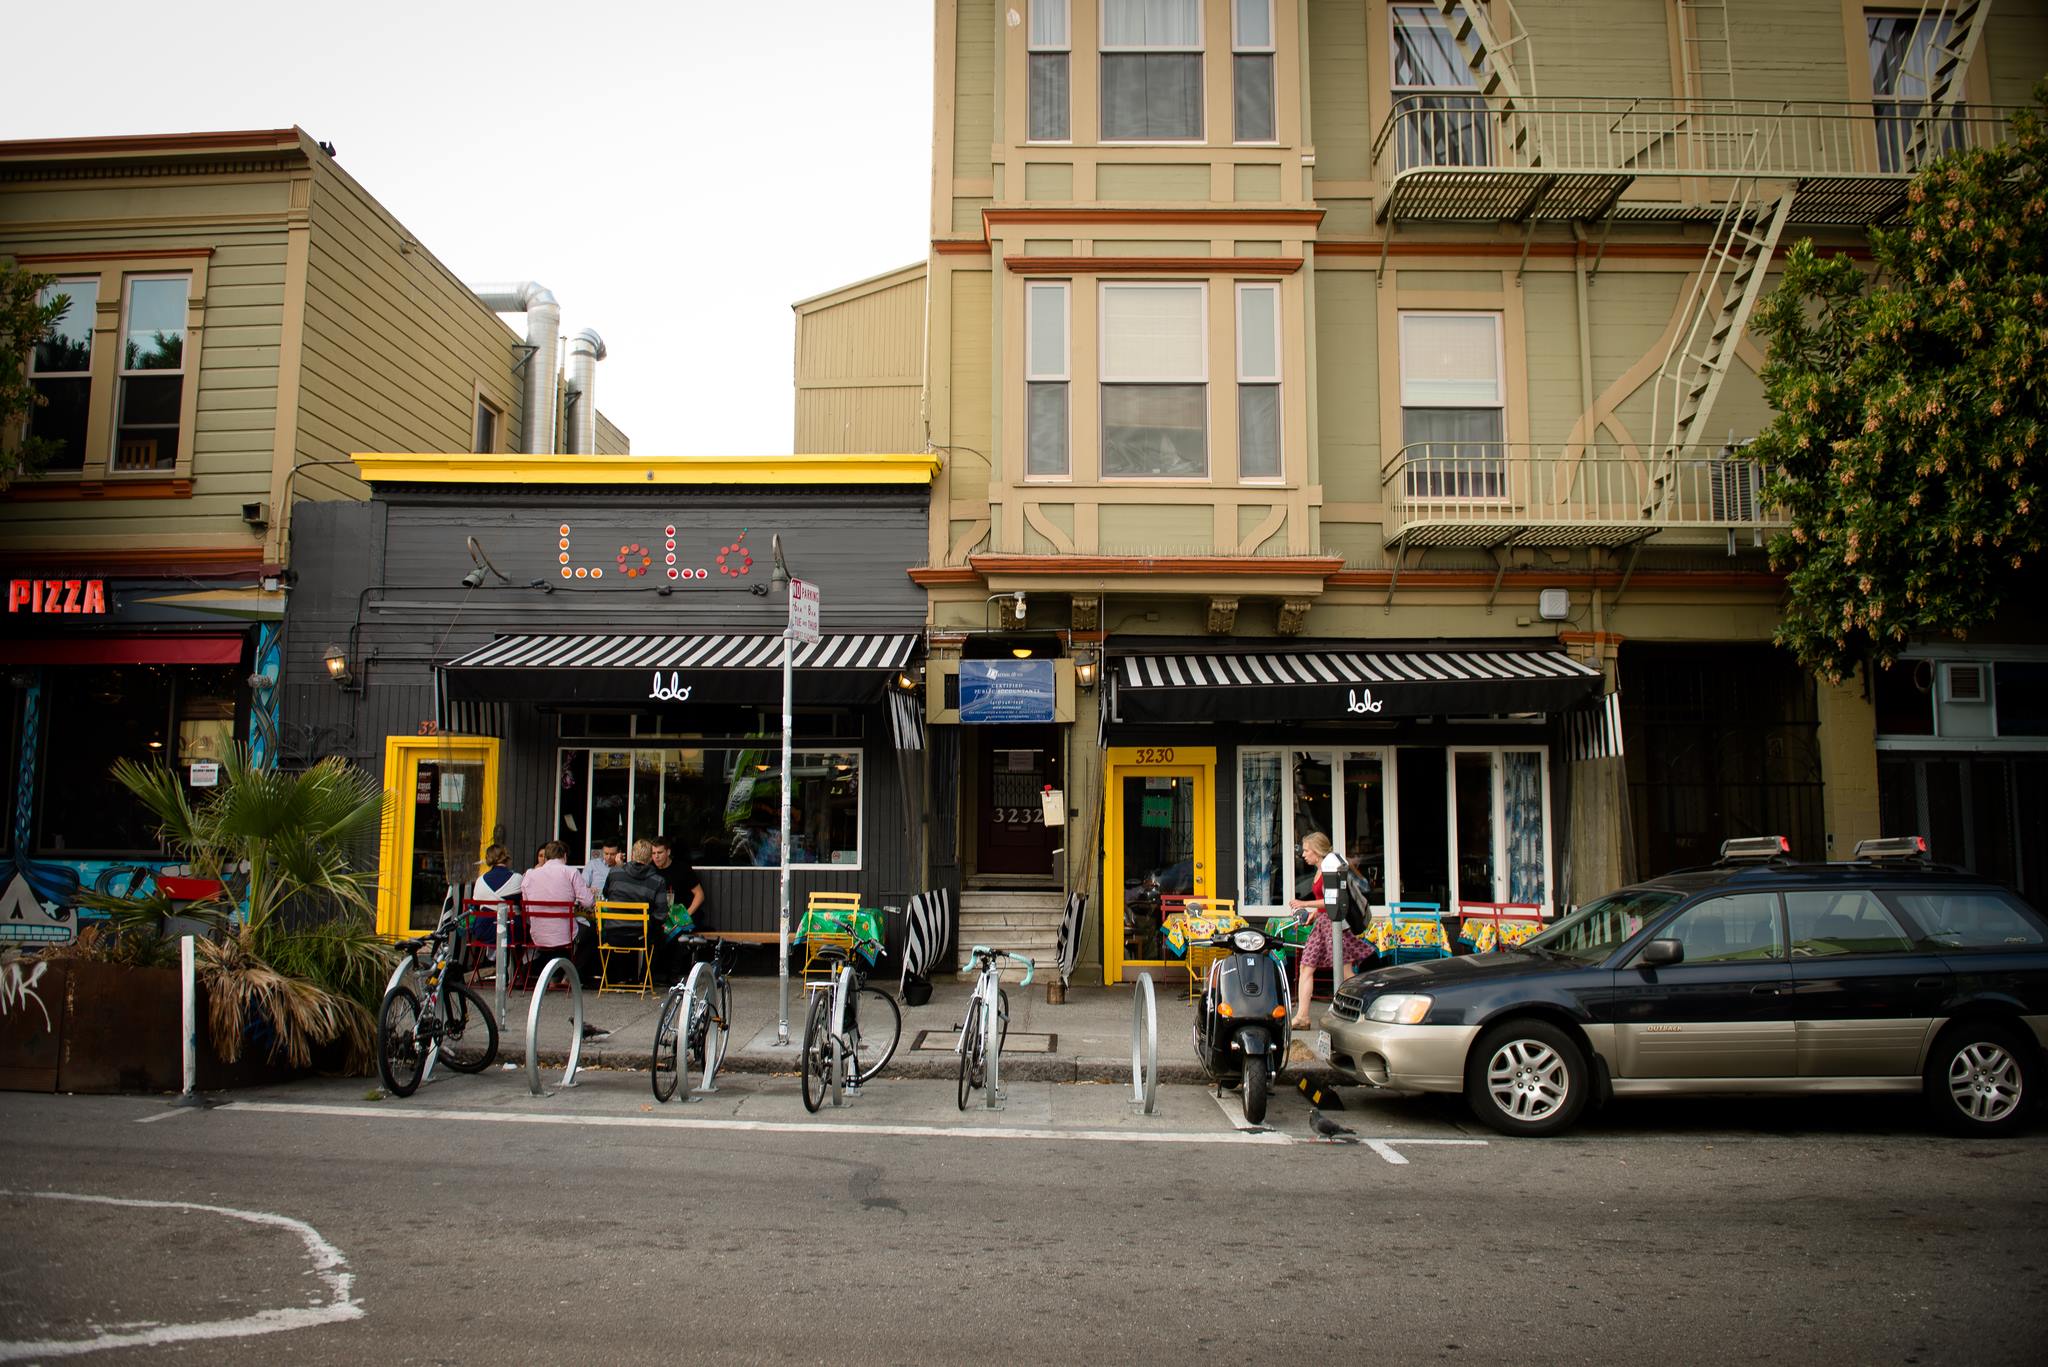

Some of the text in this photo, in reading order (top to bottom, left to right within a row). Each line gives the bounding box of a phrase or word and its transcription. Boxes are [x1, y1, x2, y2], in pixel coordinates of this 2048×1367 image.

[9, 579, 105, 613] PIZZA
[1135, 747, 1175, 764] 3230
[993, 807, 1044, 824] 3232
[1647, 1024, 1682, 1033] OUTBACK
